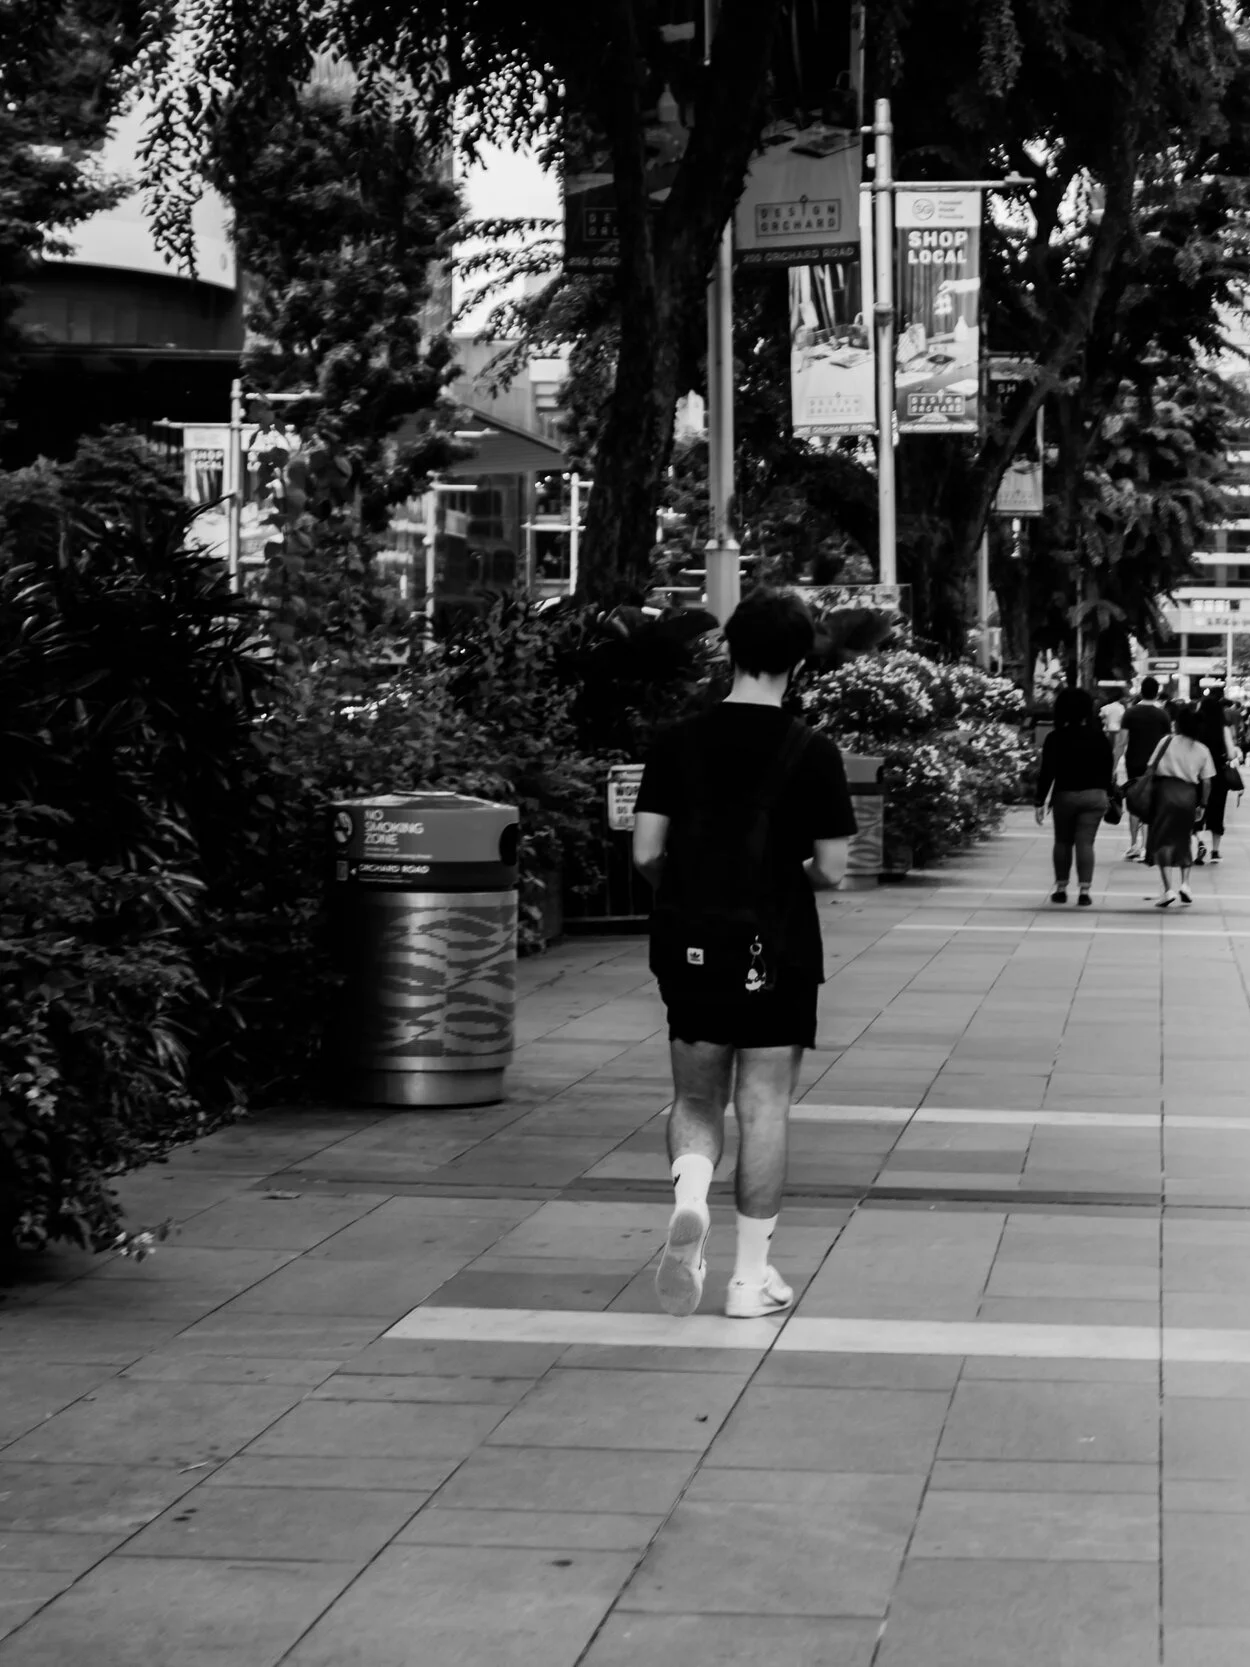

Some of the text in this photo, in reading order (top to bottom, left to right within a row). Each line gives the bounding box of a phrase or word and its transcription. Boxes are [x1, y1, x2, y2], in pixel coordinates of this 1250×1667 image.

[761, 204, 836, 219] DESIGN
[761, 217, 836, 232] ORCHARD
[908, 230, 968, 247] SHOP
[763, 249, 820, 262] ORCHARD
[822, 246, 855, 258] ROAD
[908, 249, 967, 264] LOCAL
[364, 809, 384, 821] NO
[364, 822, 424, 835] SMOKING
[364, 833, 398, 846] ZONE
[359, 864, 430, 874] ORCHARD ROAD
